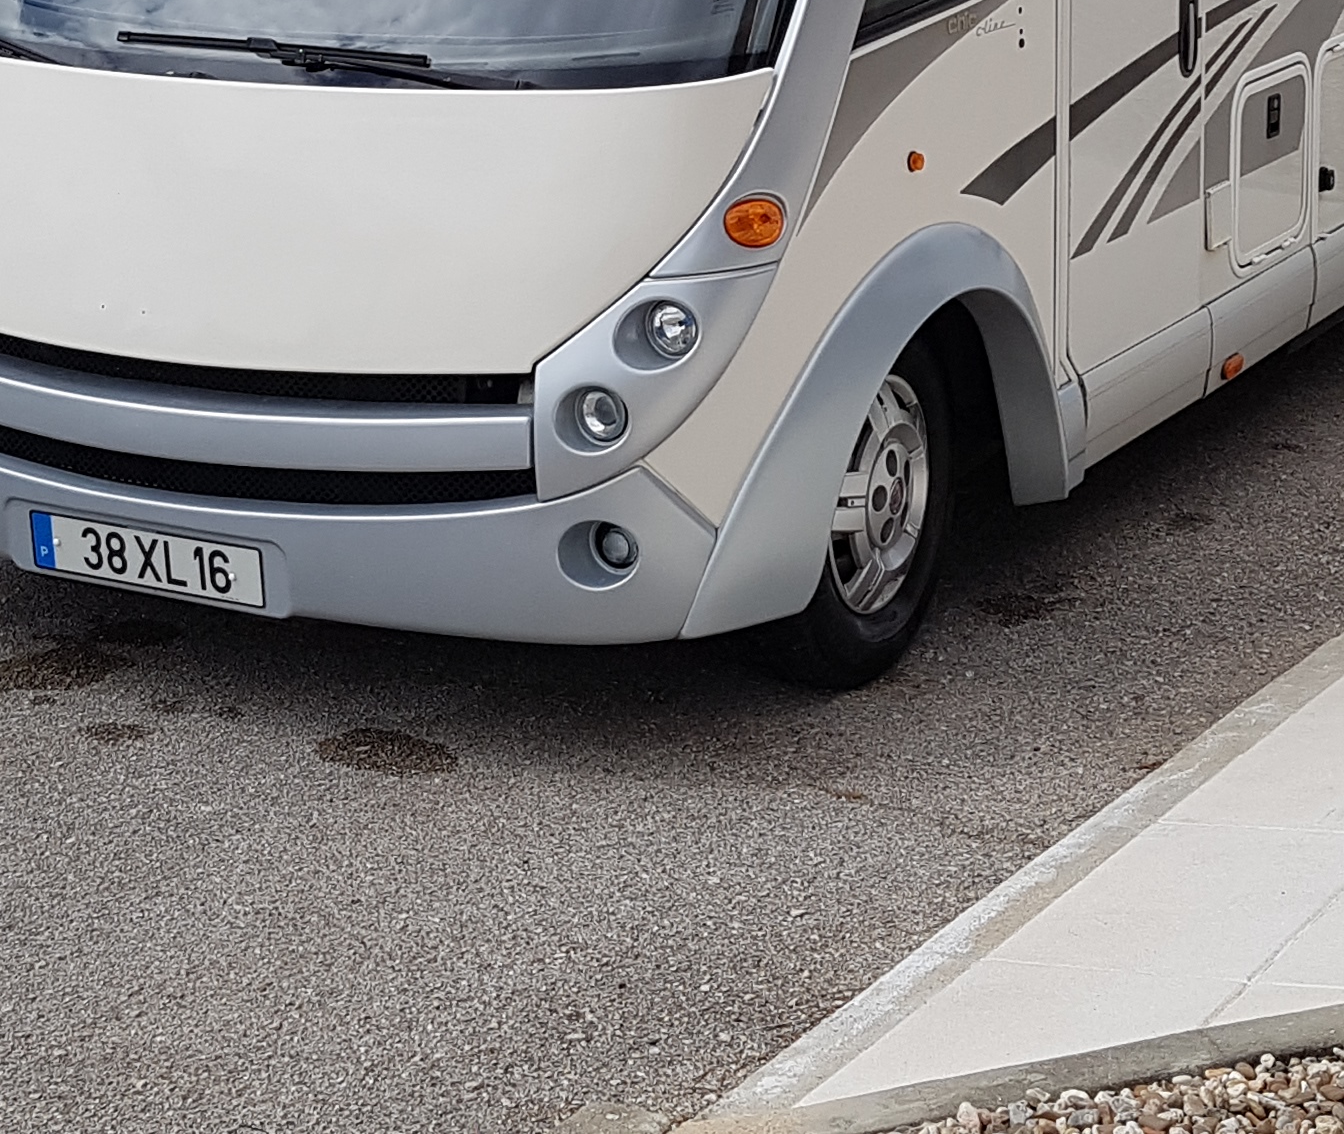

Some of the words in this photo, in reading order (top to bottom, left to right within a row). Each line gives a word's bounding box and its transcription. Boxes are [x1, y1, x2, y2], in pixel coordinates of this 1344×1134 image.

[40, 545, 49, 558] P
[80, 527, 128, 575] 38
[134, 535, 188, 588] XL
[193, 546, 233, 594] 16
